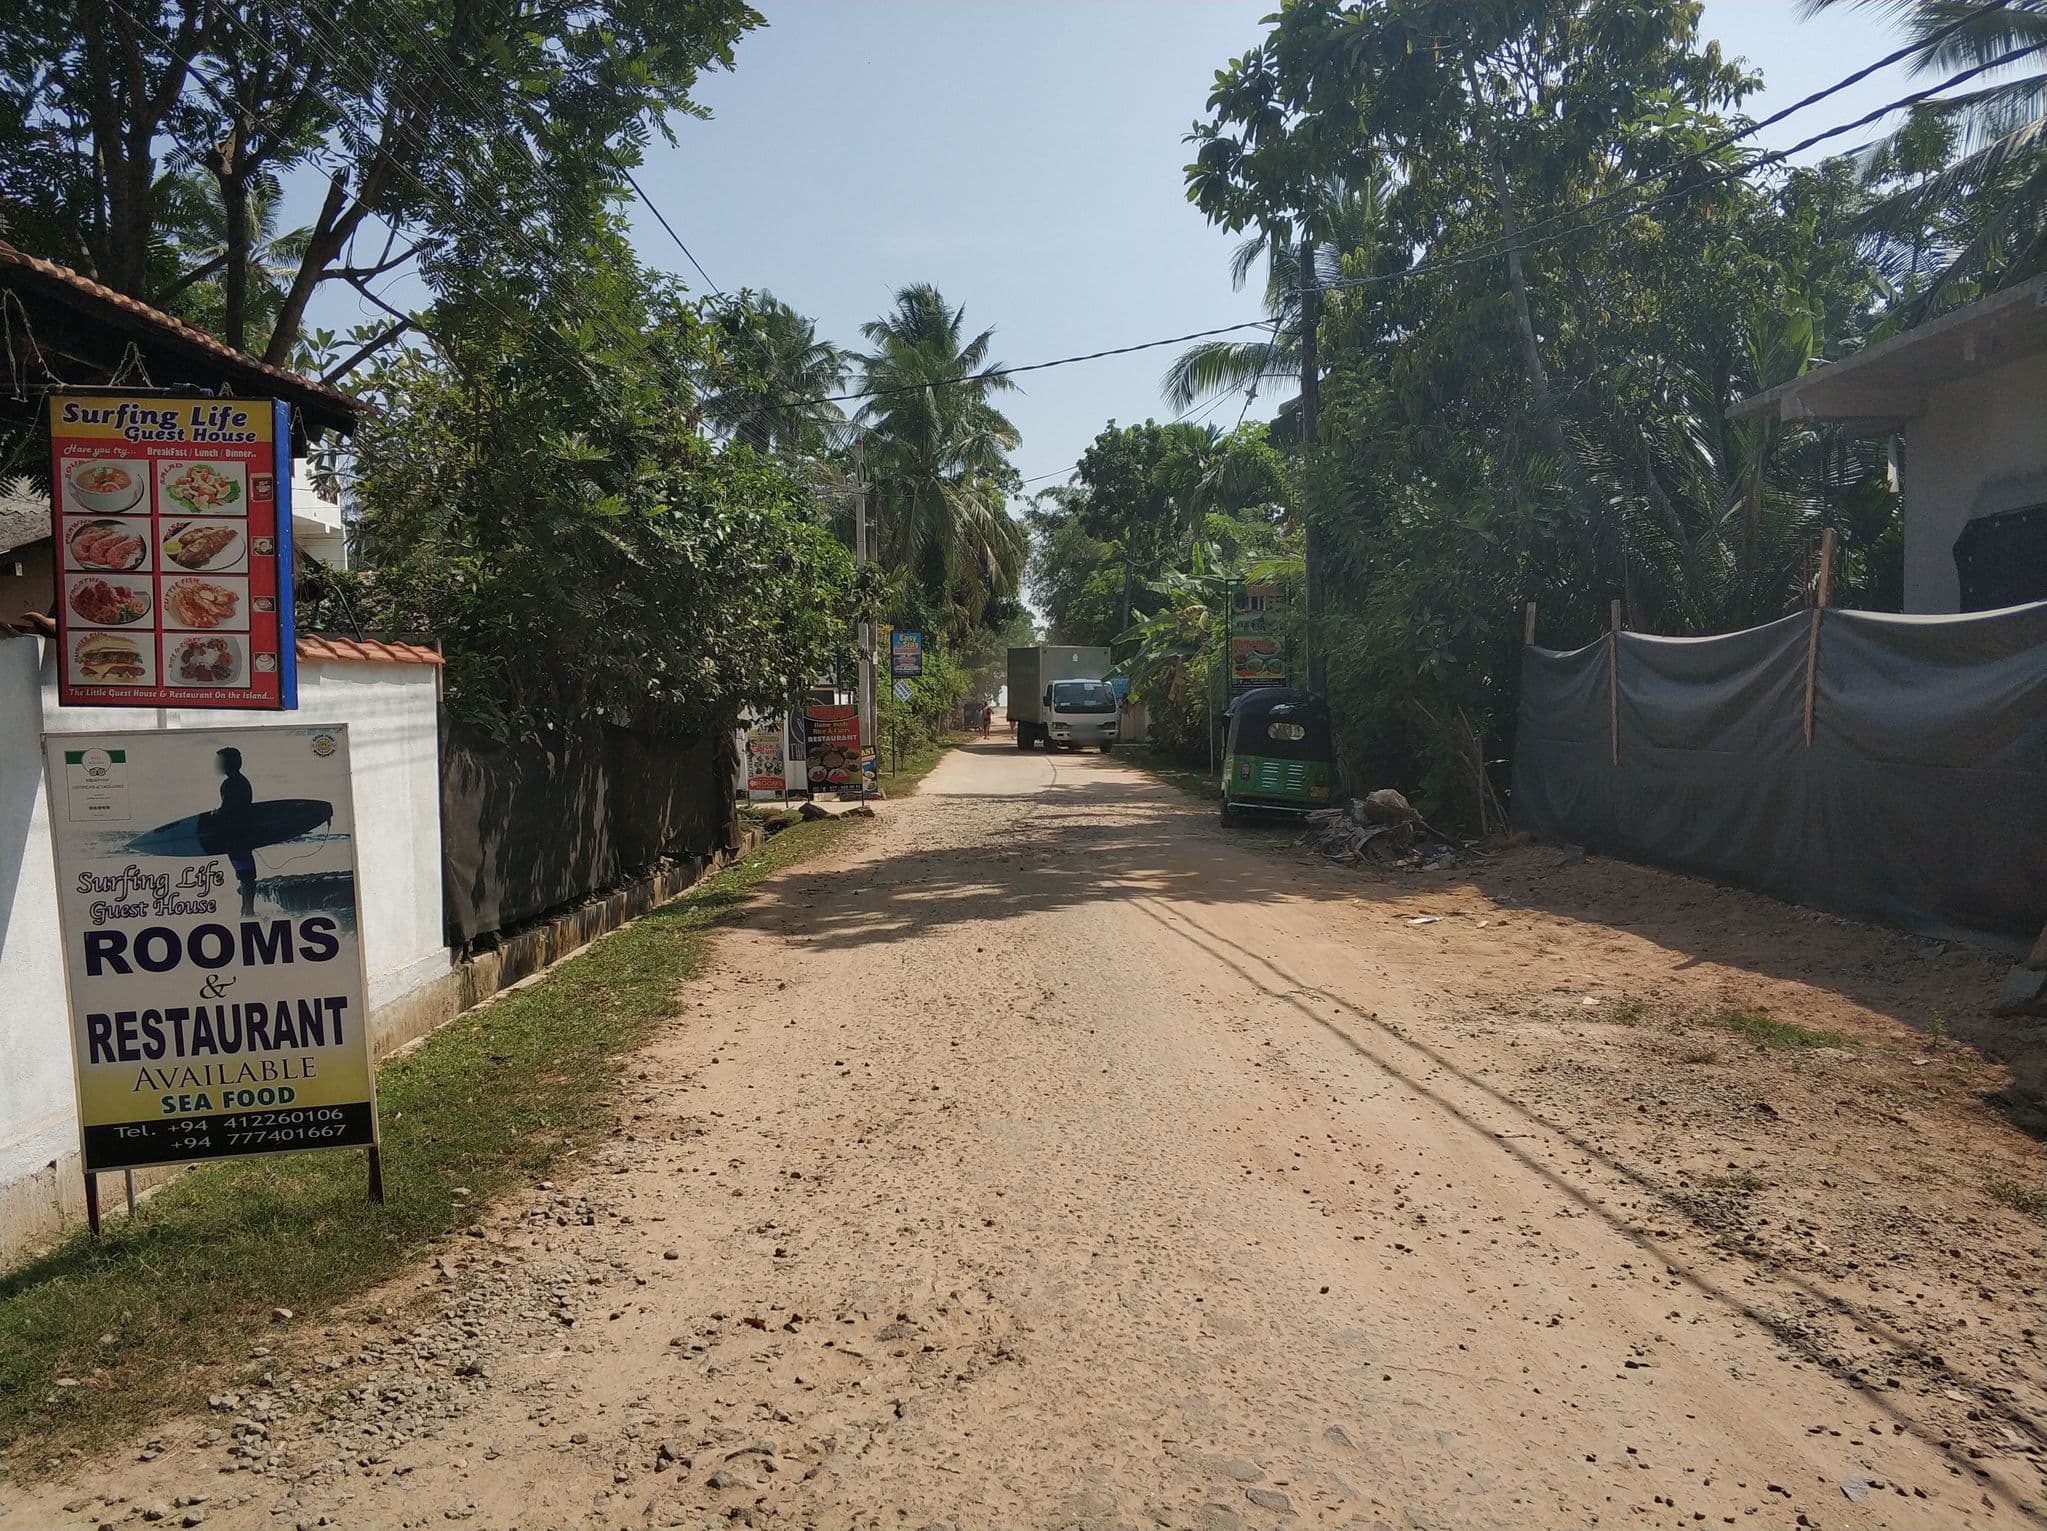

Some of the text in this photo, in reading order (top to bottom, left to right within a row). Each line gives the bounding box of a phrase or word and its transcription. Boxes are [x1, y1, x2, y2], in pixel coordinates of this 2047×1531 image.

[62, 403, 248, 431] Surfing Life
[124, 426, 256, 442] Guest House
[63, 443, 92, 455] Have
[92, 447, 110, 457] you
[194, 448, 218, 457] Lunch
[160, 463, 183, 485] SALAD
[69, 688, 83, 696] The
[86, 688, 106, 696] Little
[108, 689, 131, 697] Guest
[133, 689, 157, 697] House
[169, 690, 212, 699] Restaurant
[215, 691, 225, 699] On
[228, 691, 240, 699] the
[807, 734, 858, 743] RESTAURANT
[77, 860, 225, 902] Surfing Life
[89, 892, 217, 926] Guest House
[83, 917, 339, 976] ROOMS
[199, 974, 236, 999] &
[86, 996, 347, 1064] RESTAURANT
[132, 1057, 318, 1092] AVAILABLE
[161, 1086, 295, 1114] SEA FOOD
[113, 1108, 344, 1139] Tel. +94 412260106
[170, 1124, 346, 1149] +94 777401667
